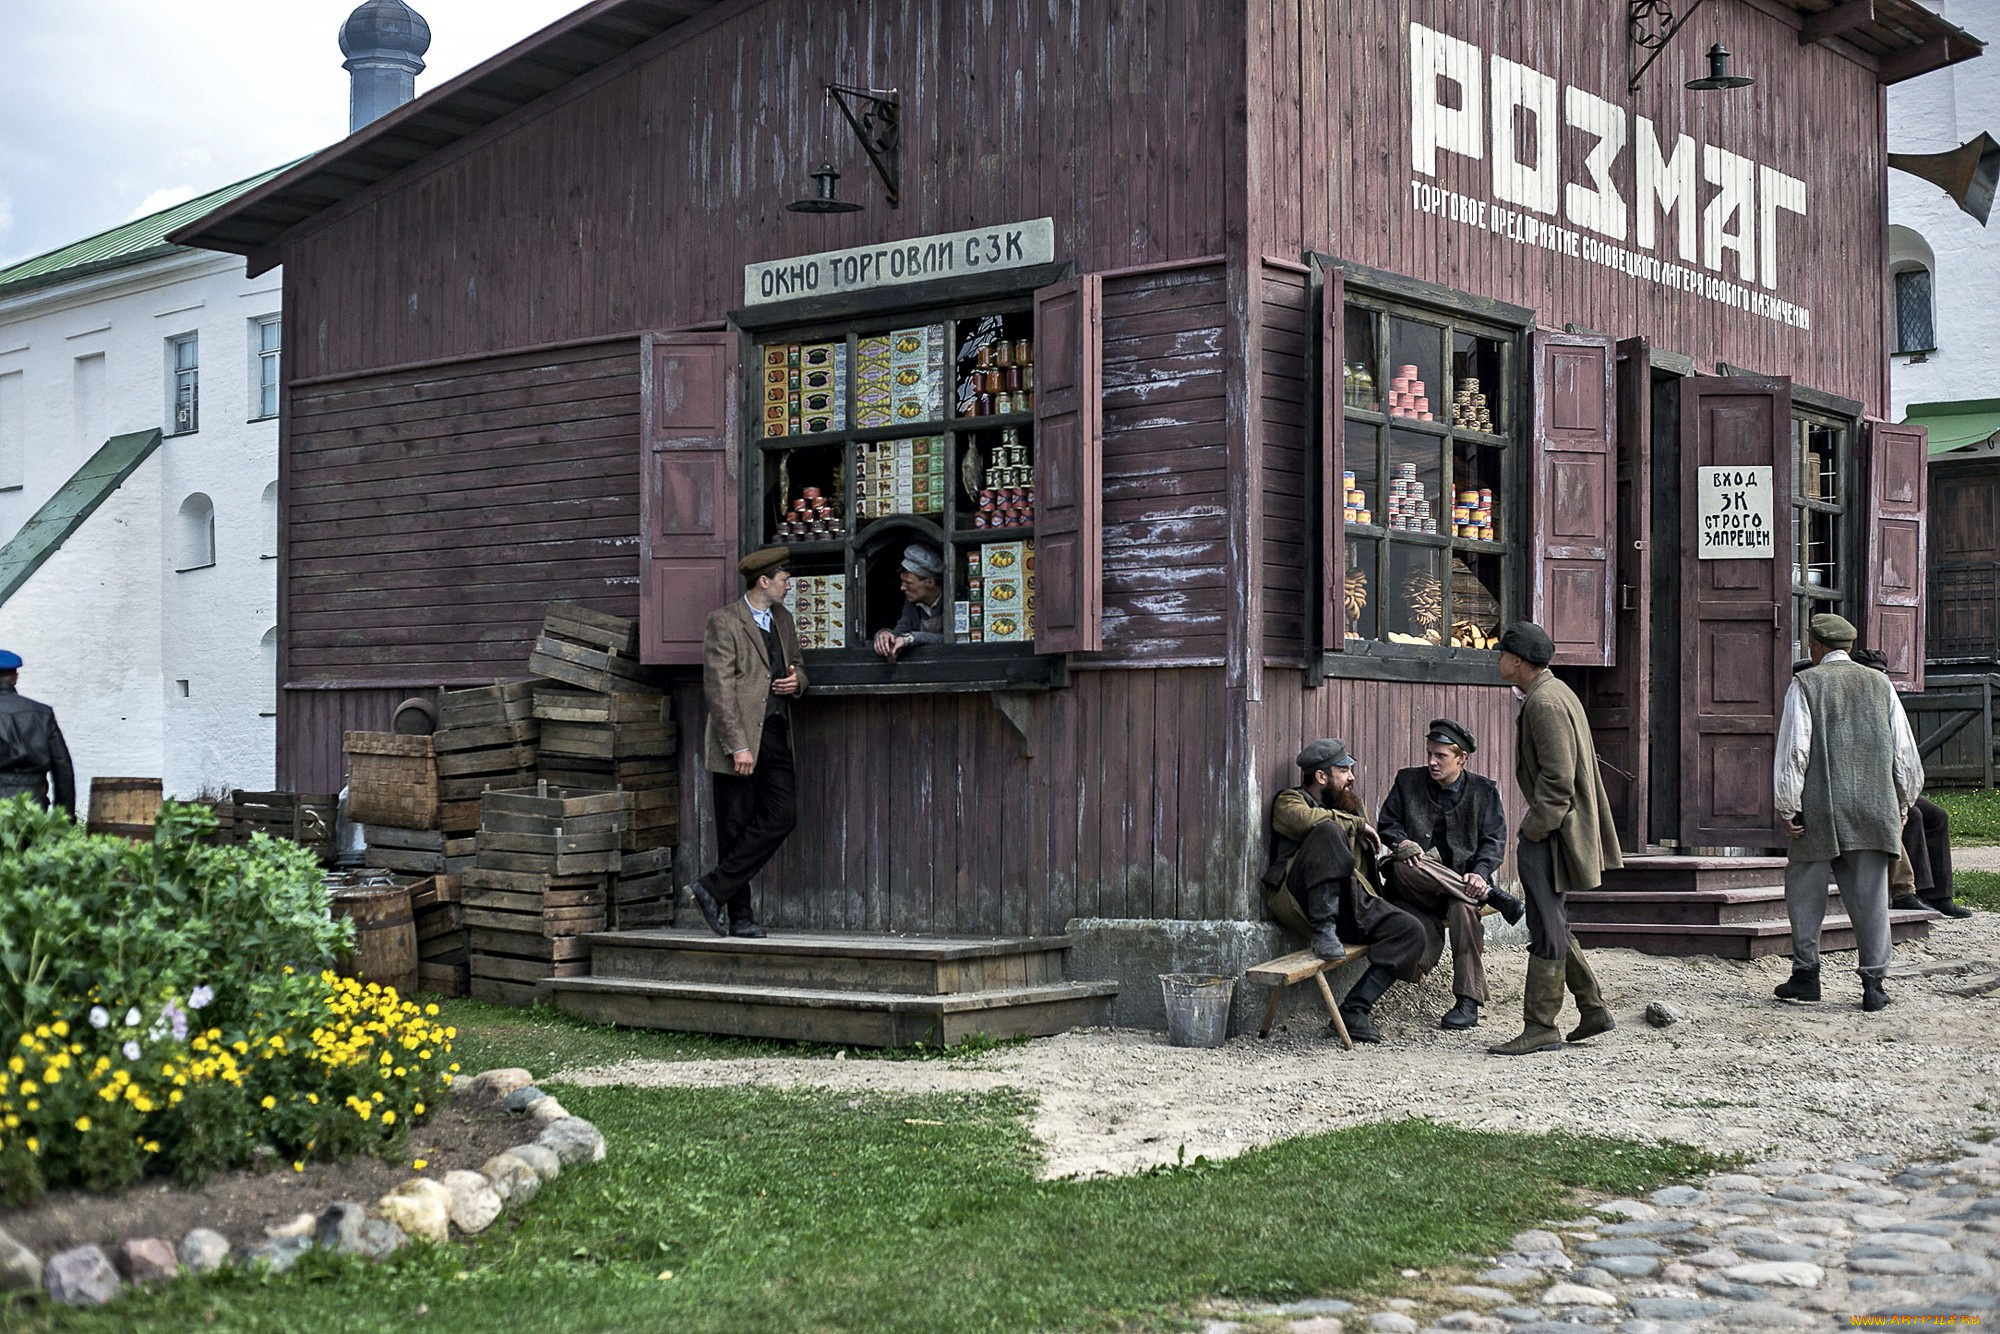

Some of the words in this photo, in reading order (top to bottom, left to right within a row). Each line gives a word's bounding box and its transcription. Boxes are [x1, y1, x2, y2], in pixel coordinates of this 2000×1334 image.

[1410, 22, 1807, 290] РОЗМАГ
[1411, 180, 1487, 230] ТОРГОВОЕ
[1490, 205, 1580, 258] ПРЕДПРИЯТИЕ
[1582, 235, 1661, 283] СОЛОВЕЦКОГО
[1661, 261, 1704, 297] ЛАГЕРЯ
[1705, 275, 1750, 312] ОСОБОГО
[1751, 290, 1810, 331] НАЗНАЧЕНИЯ
[760, 261, 819, 298] ОКНО
[829, 240, 953, 287] ТОРГОВЛИ
[1713, 471, 1758, 488] ВХОД
[1720, 490, 1748, 512] ЗК
[1704, 512, 1763, 530] СТРОГО
[1703, 527, 1770, 549] ЗАПРЕЩЁН
